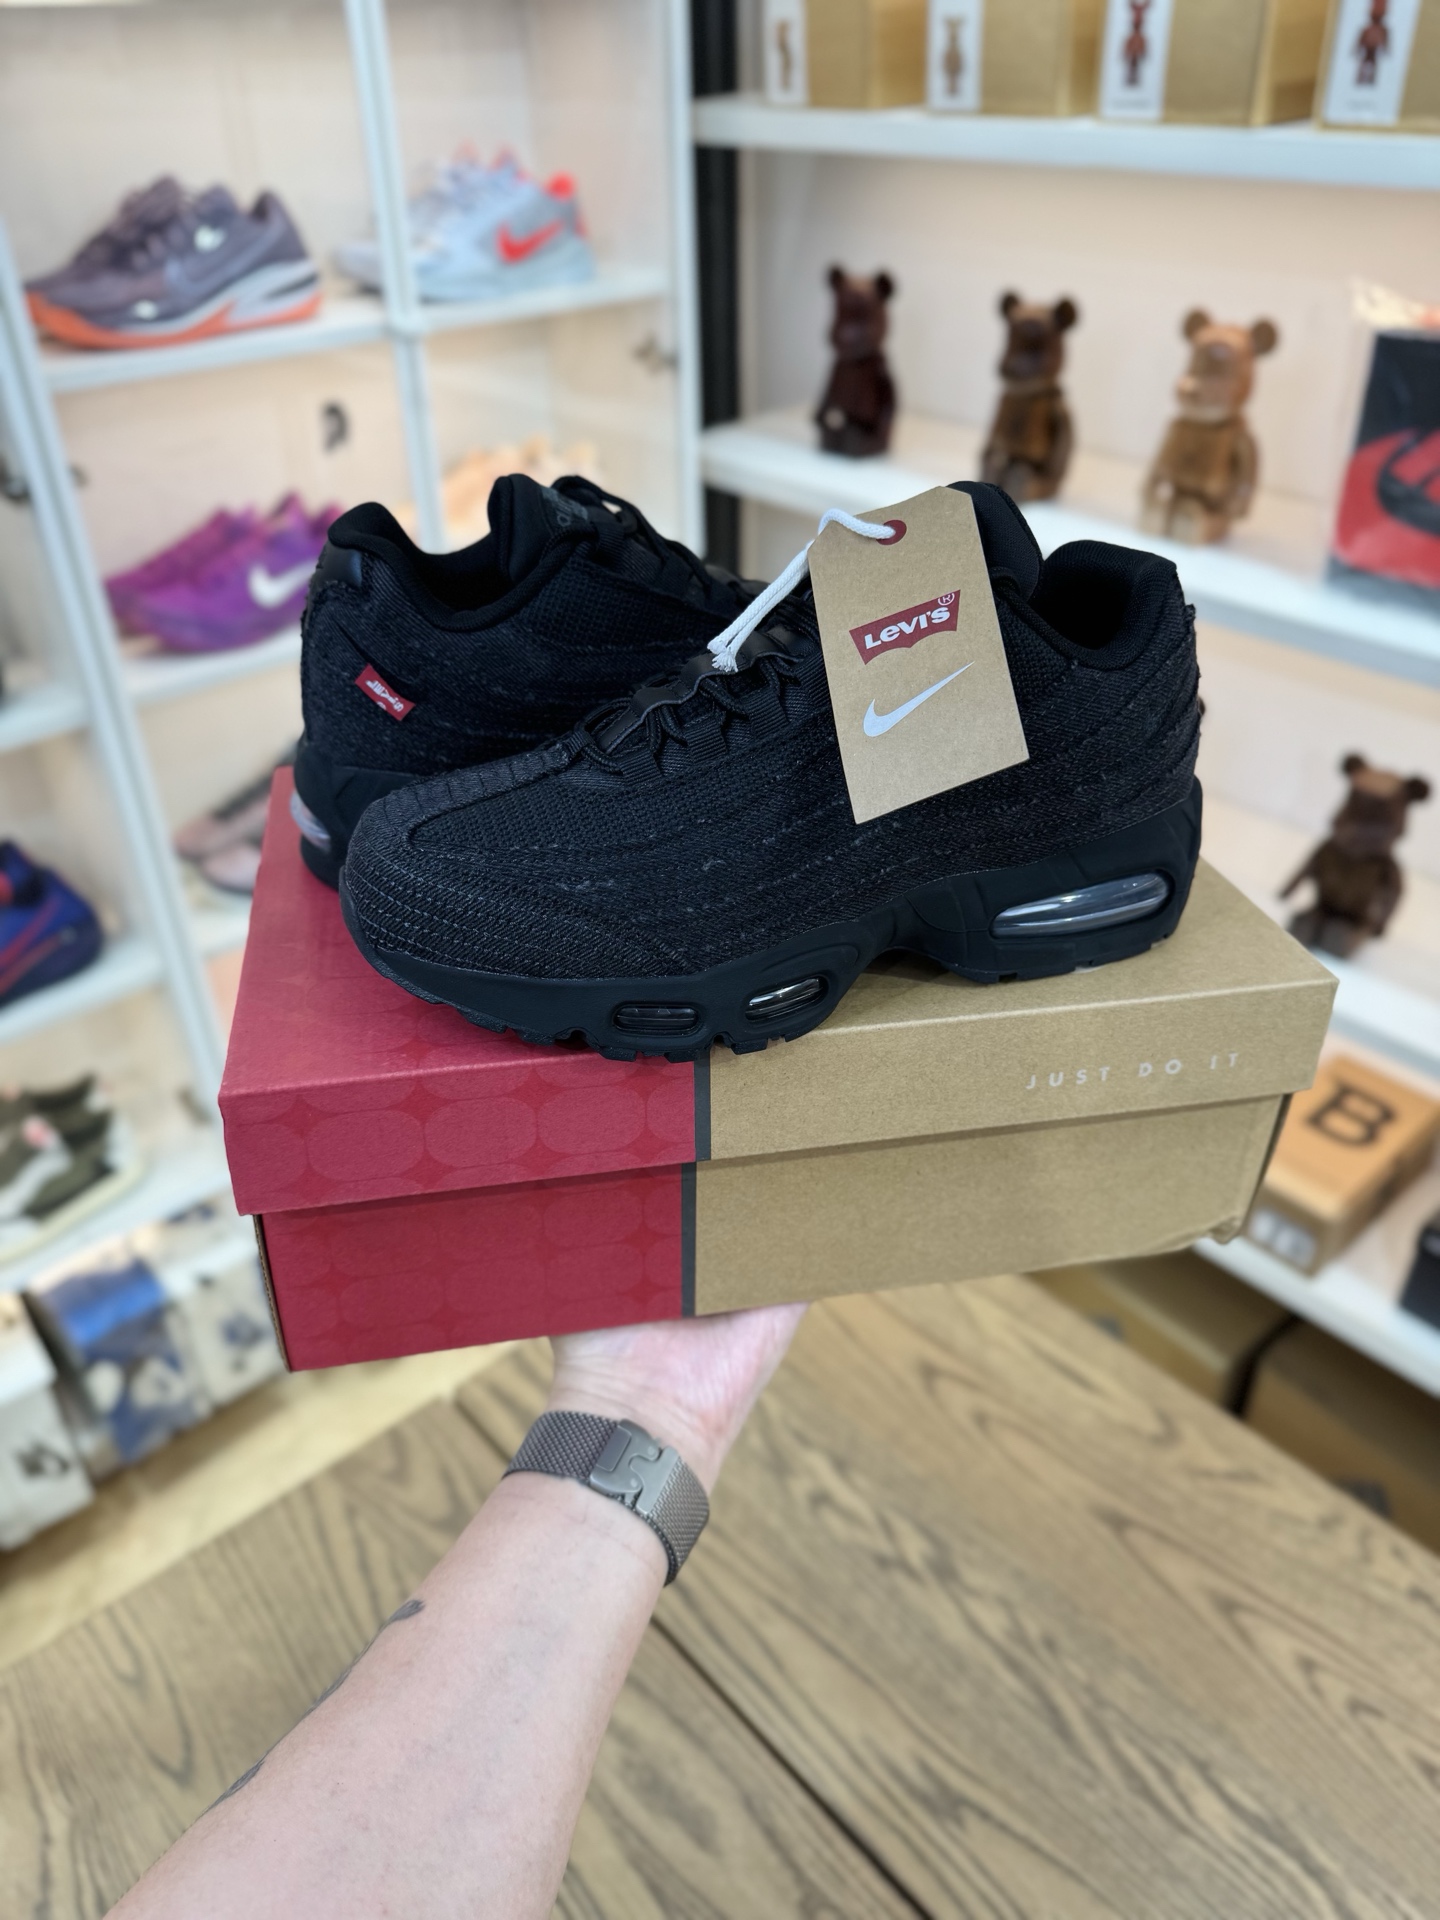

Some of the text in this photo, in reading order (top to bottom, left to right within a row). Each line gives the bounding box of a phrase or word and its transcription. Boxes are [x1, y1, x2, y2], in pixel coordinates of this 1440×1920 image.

[1025, 1053, 1239, 1090] JUST DO IT
